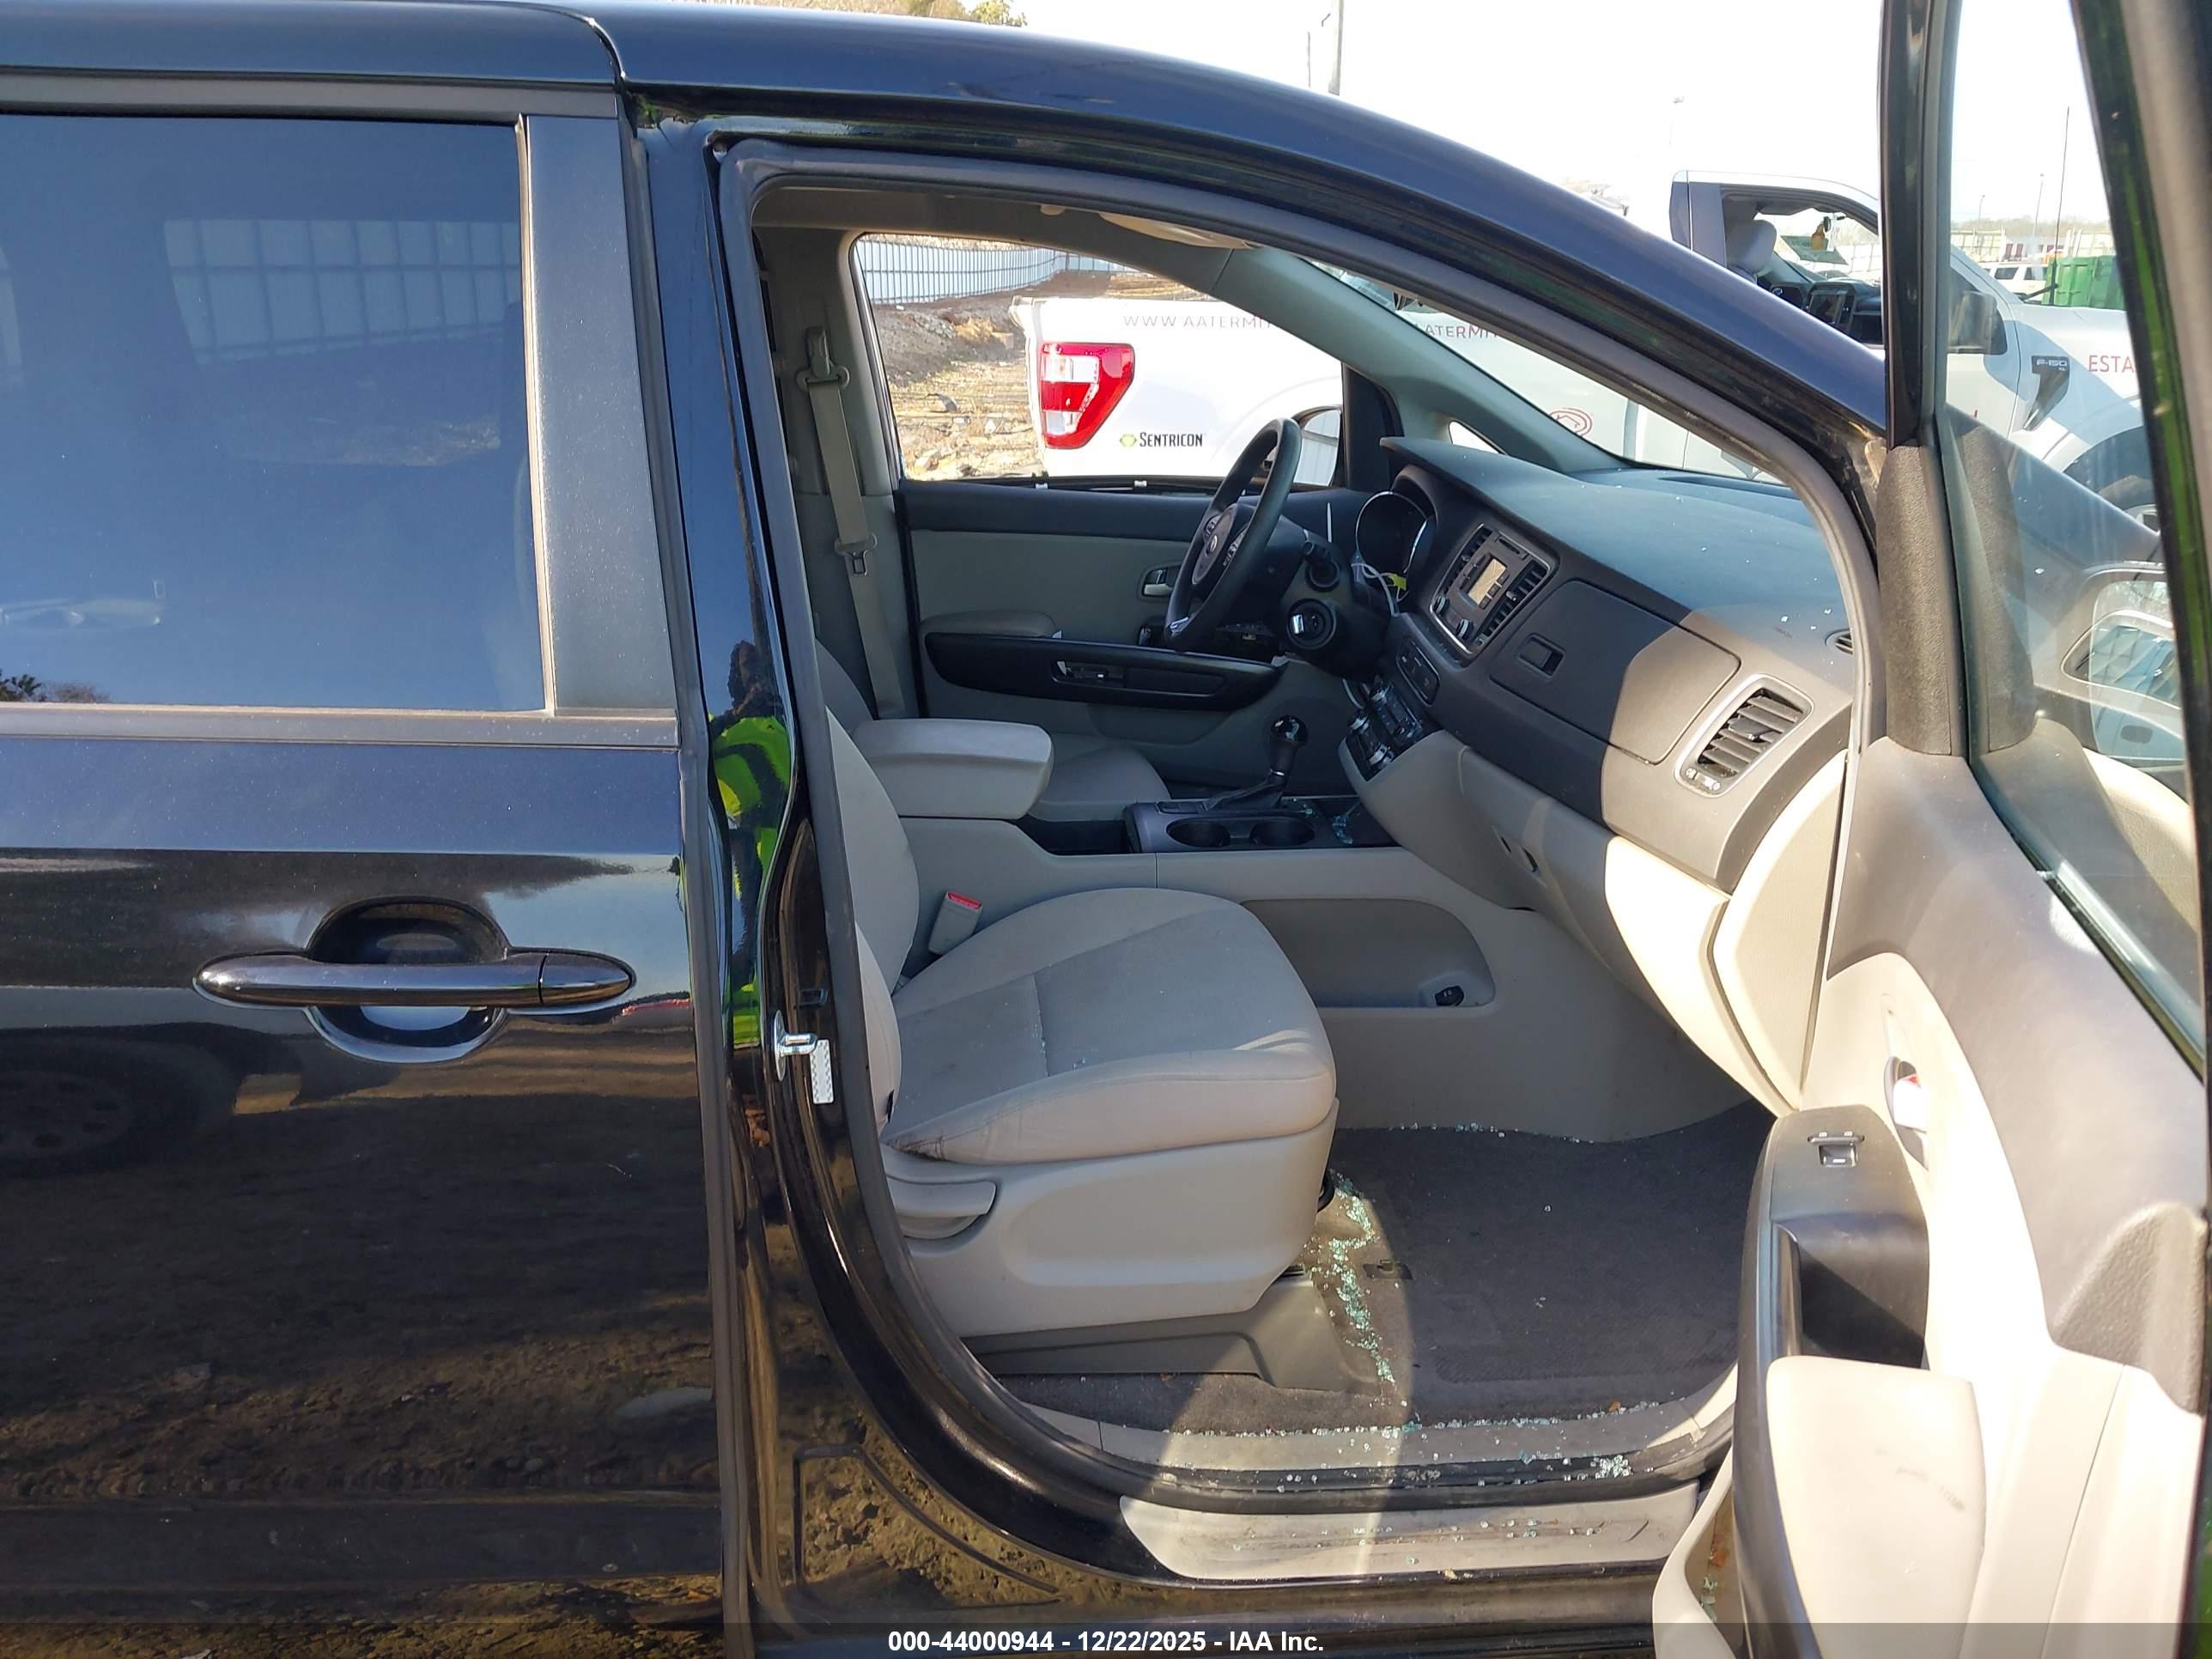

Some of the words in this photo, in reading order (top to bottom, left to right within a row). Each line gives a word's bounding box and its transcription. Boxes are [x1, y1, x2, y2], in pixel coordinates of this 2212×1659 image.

[2036, 358, 2068, 368] F-150
[2088, 355, 2135, 373] ESTA
[1139, 431, 1203, 447] SENTRICON
